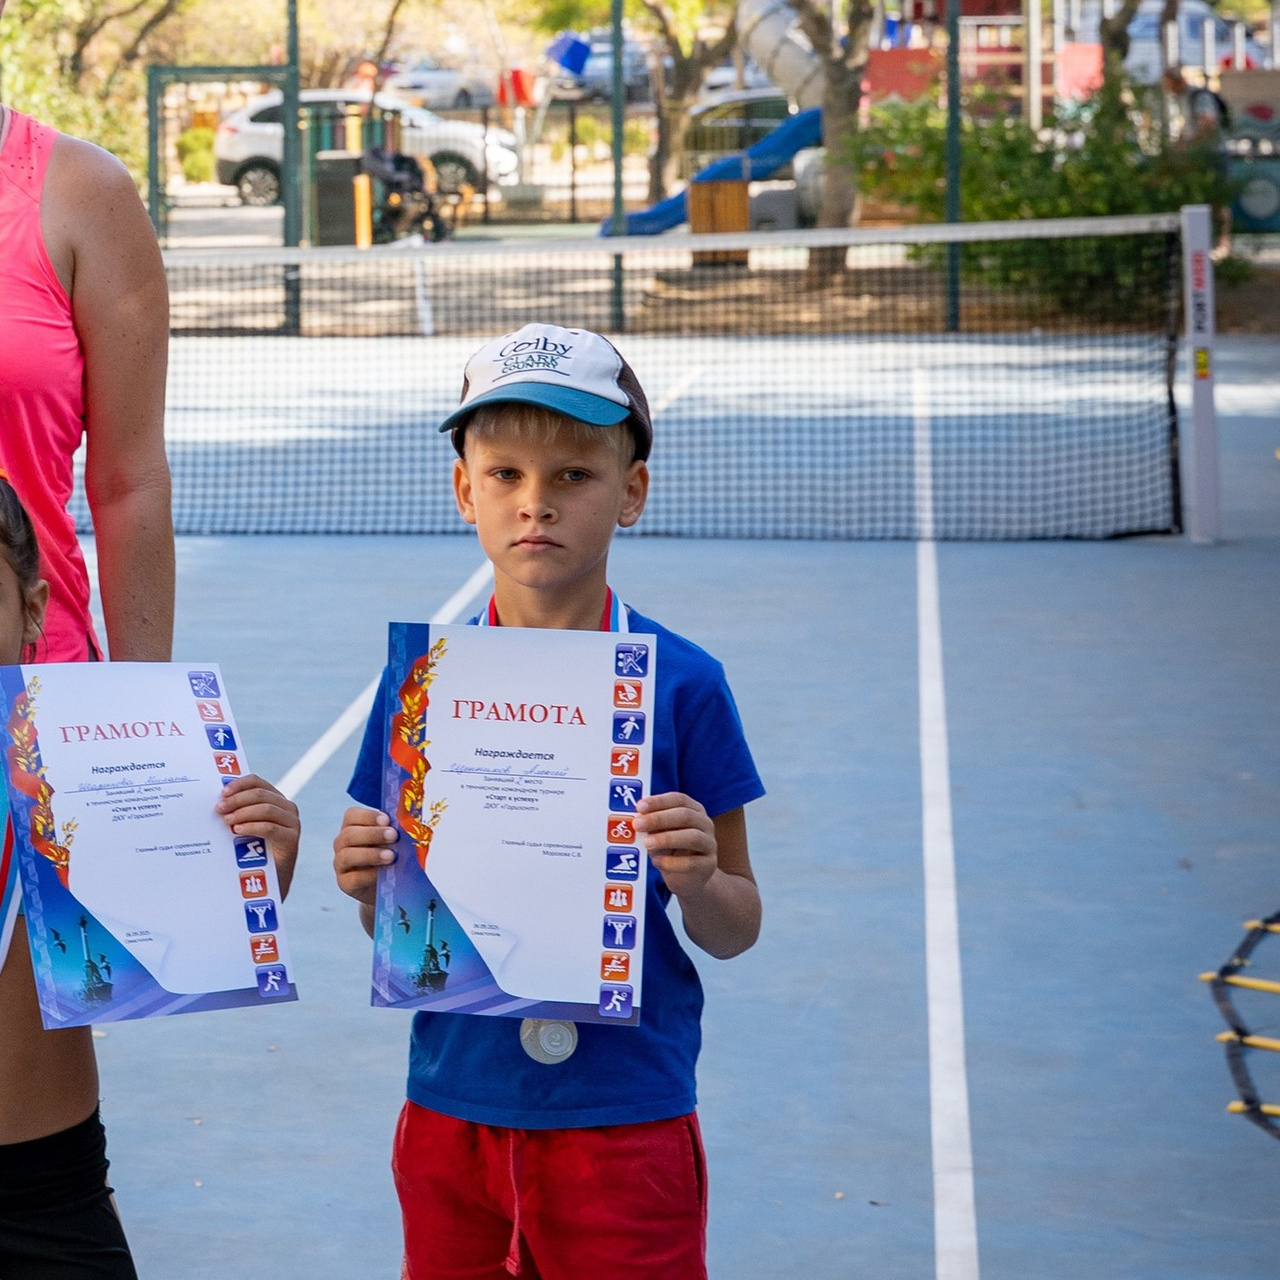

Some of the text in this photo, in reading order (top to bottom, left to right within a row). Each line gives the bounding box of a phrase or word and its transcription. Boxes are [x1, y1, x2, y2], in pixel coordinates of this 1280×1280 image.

[500, 336, 573, 357] Colby
[504, 355, 560, 366] CLARK
[452, 699, 587, 725] ГРАМОТА
[59, 721, 185, 743] ГРАМОТА
[474, 747, 554, 760] Награждается
[91, 761, 166, 774] Награждается
